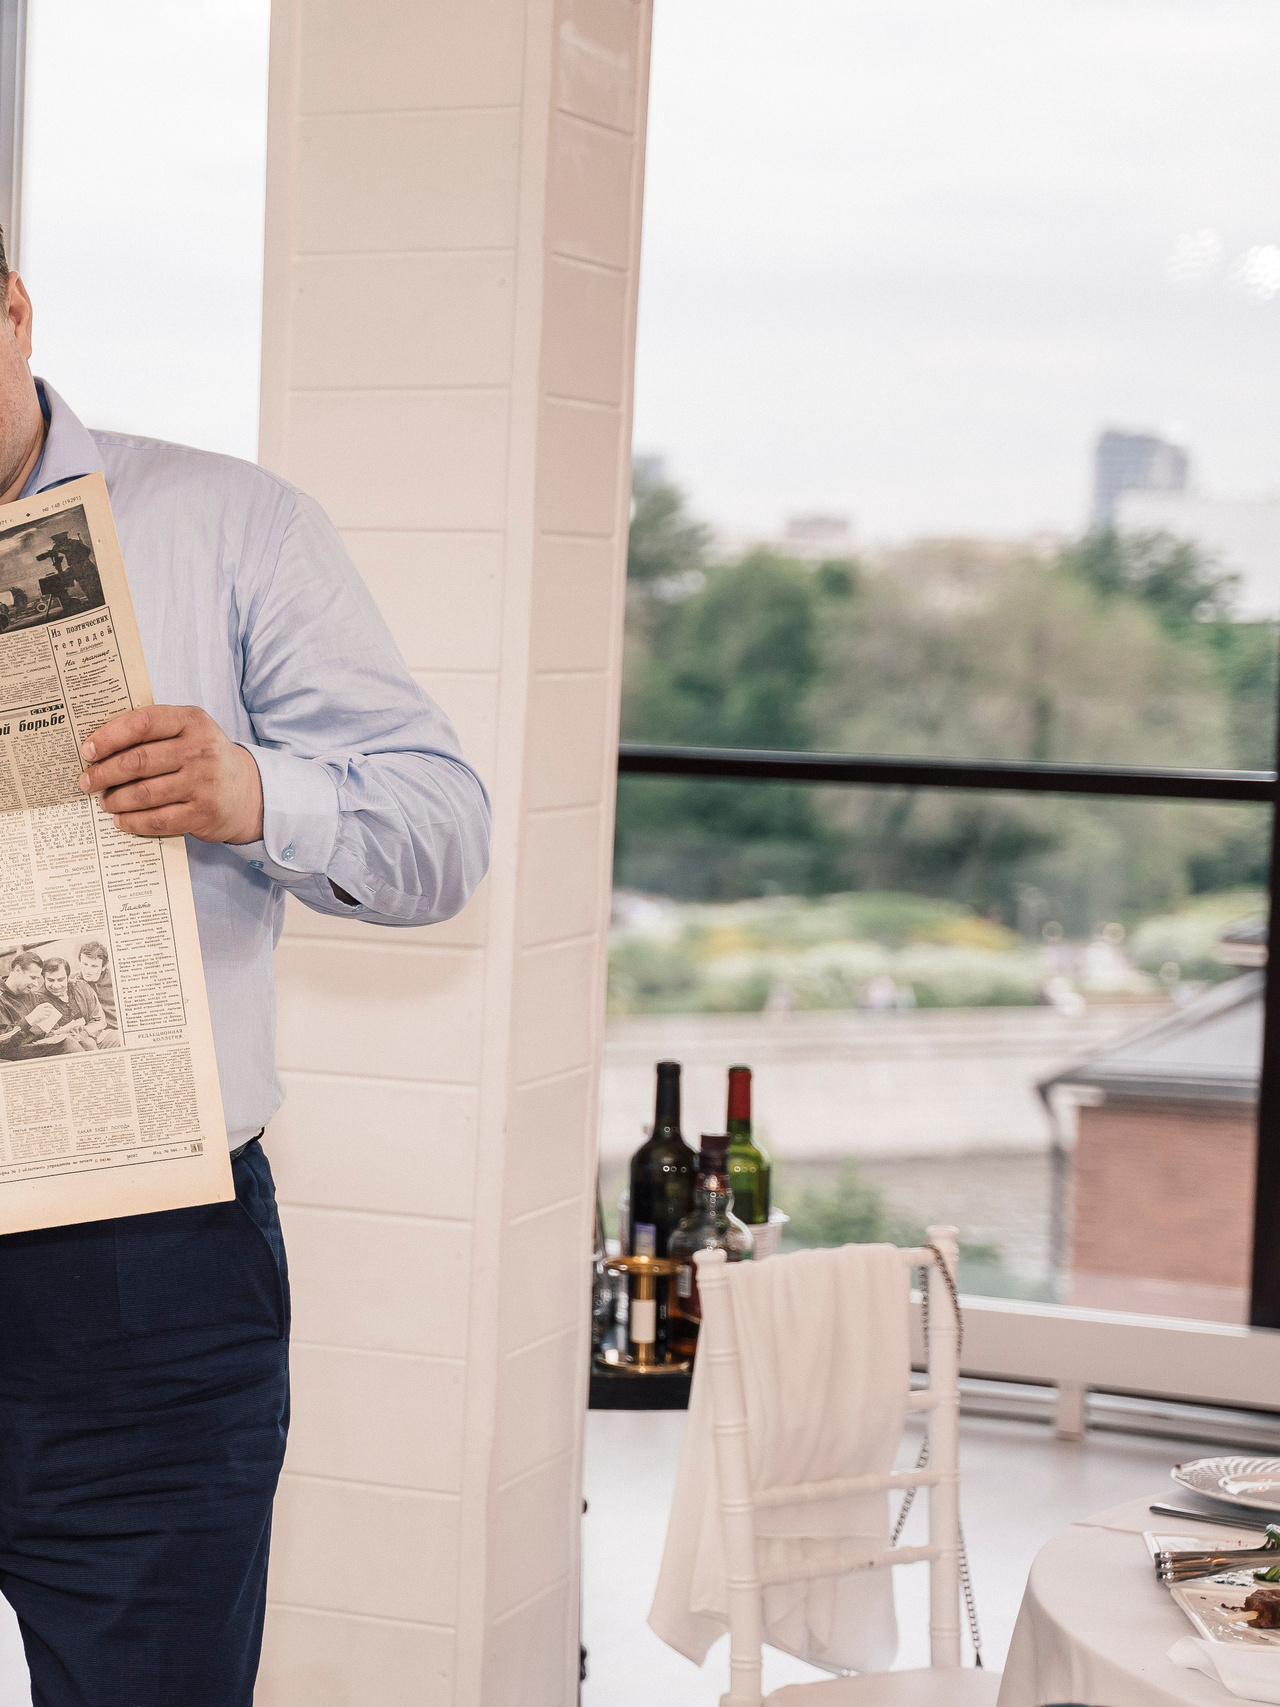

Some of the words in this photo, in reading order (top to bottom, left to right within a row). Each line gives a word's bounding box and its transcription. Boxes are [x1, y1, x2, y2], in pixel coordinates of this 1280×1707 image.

[50, 628, 62, 638] Из
[66, 614, 109, 634] поэтических
[54, 625, 113, 651] тетрадей
[82, 650, 110, 664] границе
[30, 703, 65, 716] СПОРТ
[18, 712, 66, 733] борьбе
[120, 902, 152, 912] Память
